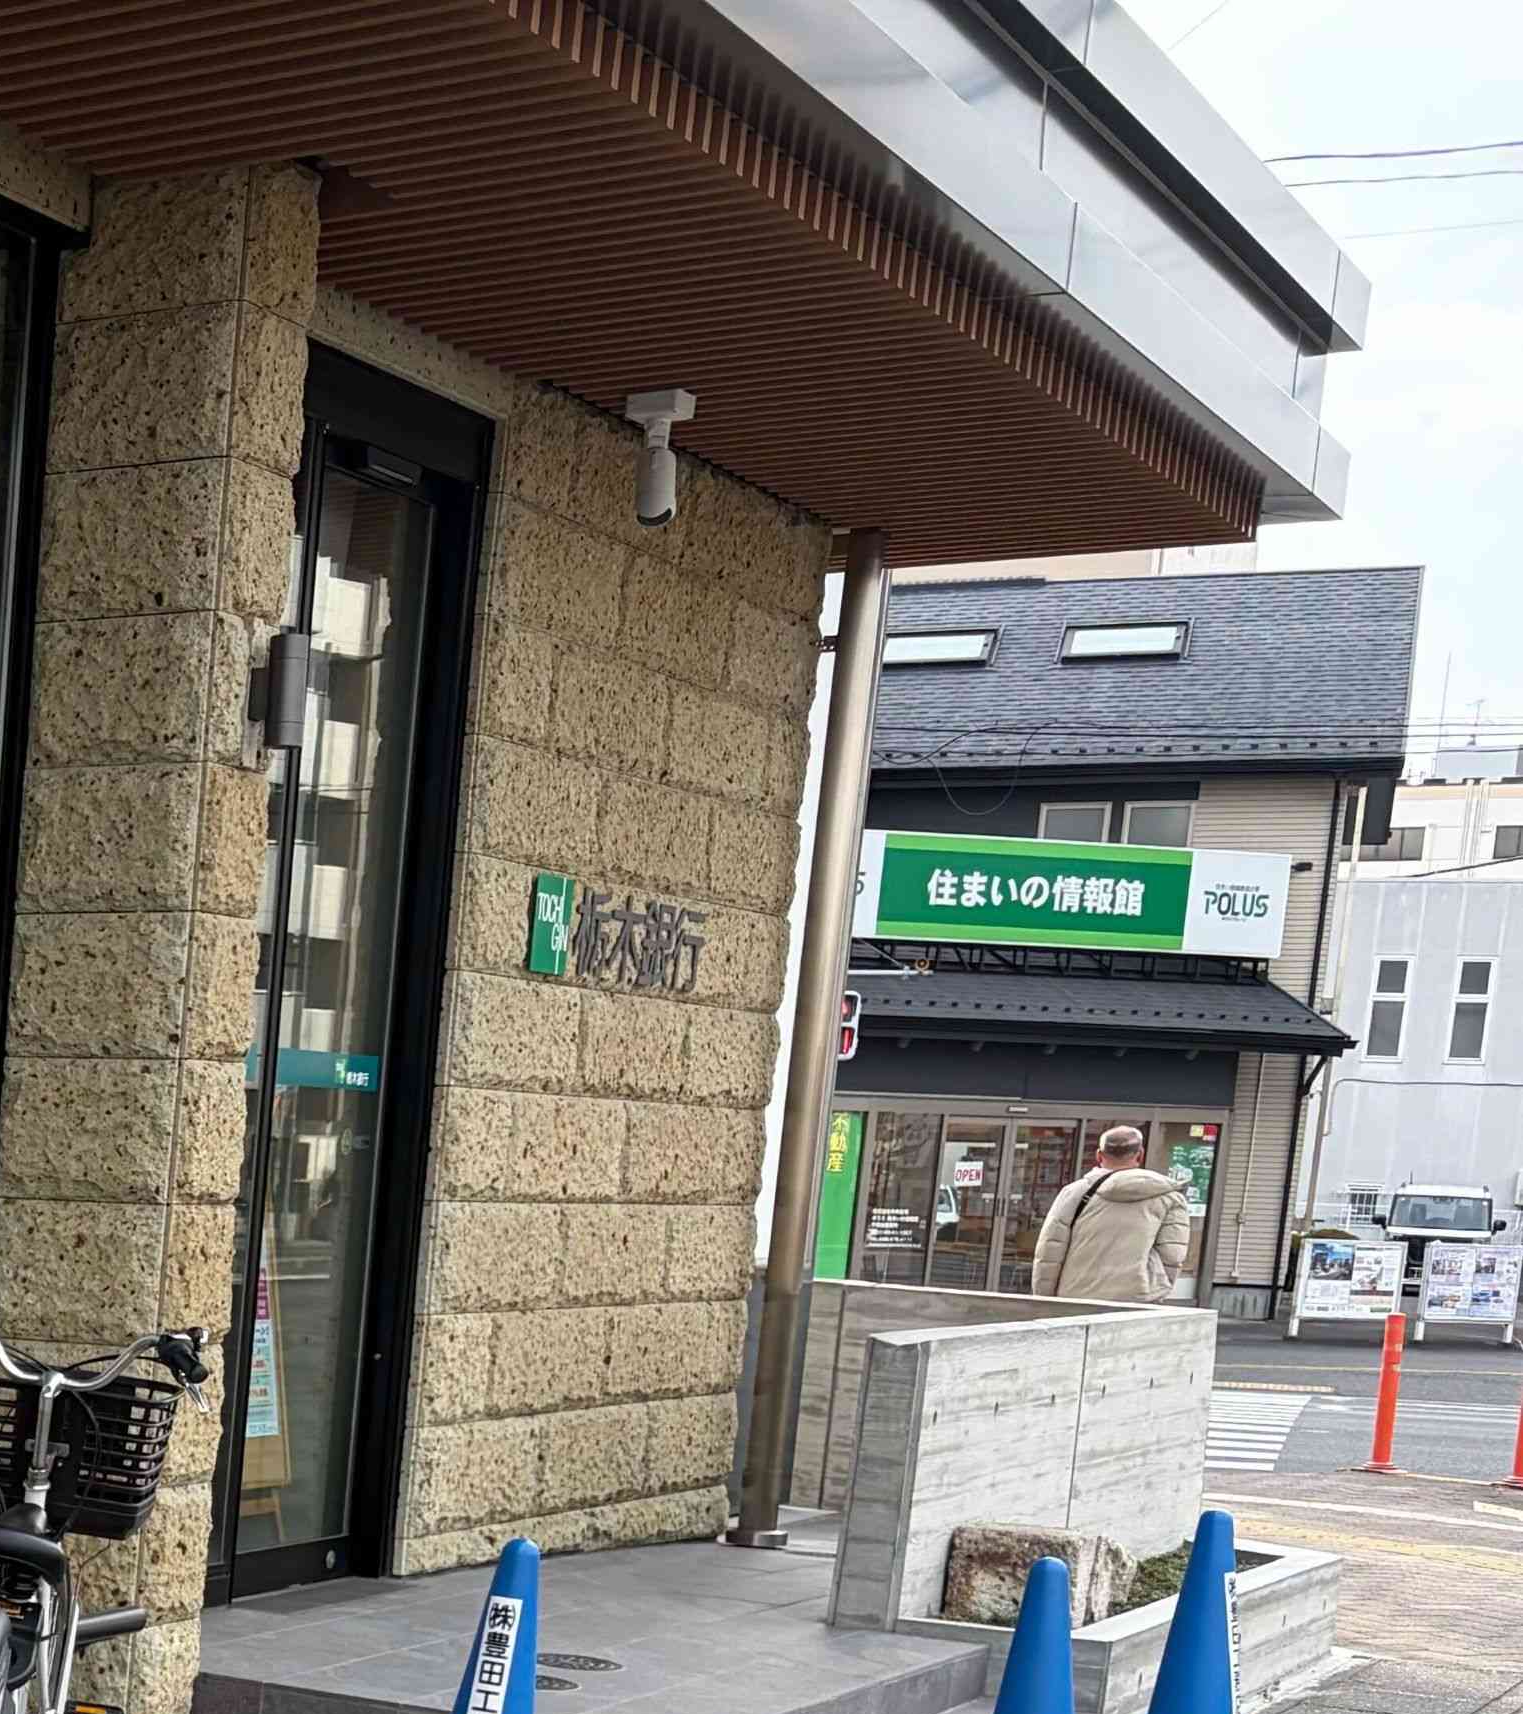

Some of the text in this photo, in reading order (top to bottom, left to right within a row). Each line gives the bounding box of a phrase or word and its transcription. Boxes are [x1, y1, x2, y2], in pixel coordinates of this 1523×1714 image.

[926, 867, 1146, 917] 住まいの情報館
[1203, 889, 1270, 918] POLUS
[572, 886, 710, 993] 栃木銀行
[826, 1112, 851, 1173] 不動産
[954, 1168, 981, 1182] OPEN
